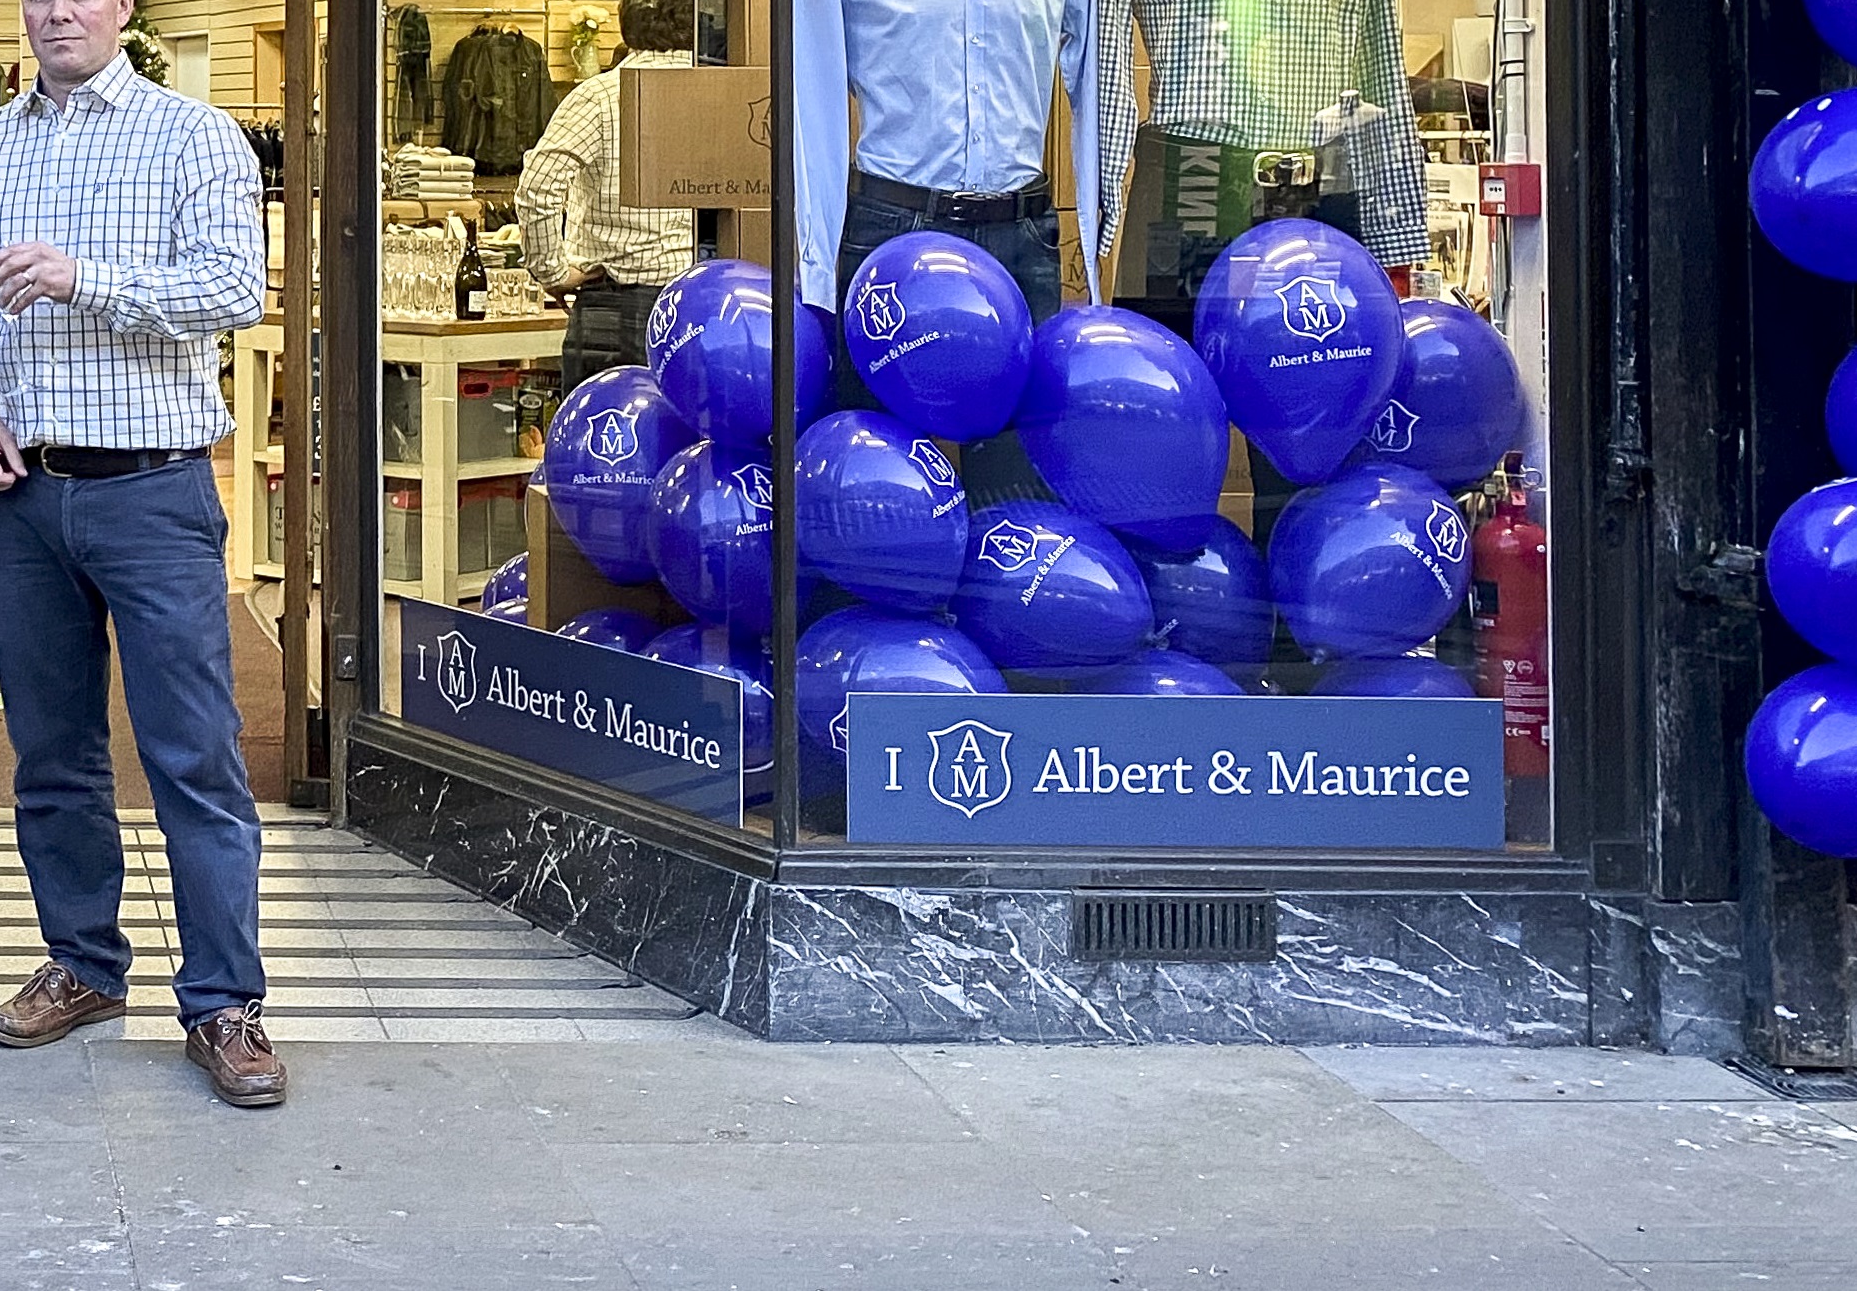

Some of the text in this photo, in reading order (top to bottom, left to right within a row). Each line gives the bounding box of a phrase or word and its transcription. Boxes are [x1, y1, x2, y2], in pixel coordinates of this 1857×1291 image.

[670, 178, 722, 195] Albert
[726, 179, 741, 194] &
[670, 323, 705, 352] Maurice
[869, 330, 941, 375] Albert & Maurice
[1269, 345, 1373, 369] Albert & Maurice
[573, 471, 655, 486] Albert & Mauric
[735, 522, 767, 537] Albert
[1021, 536, 1076, 607] Albert & Maurice
[1390, 530, 1453, 601] Albert & Maurice
[418, 644, 428, 682] I
[487, 664, 566, 724] Albert
[574, 690, 597, 733] &
[605, 697, 722, 770] Maurice
[884, 747, 903, 791] I
[1032, 746, 1195, 795] Albert
[1208, 750, 1252, 795] &
[1267, 751, 1471, 797] Maurice
